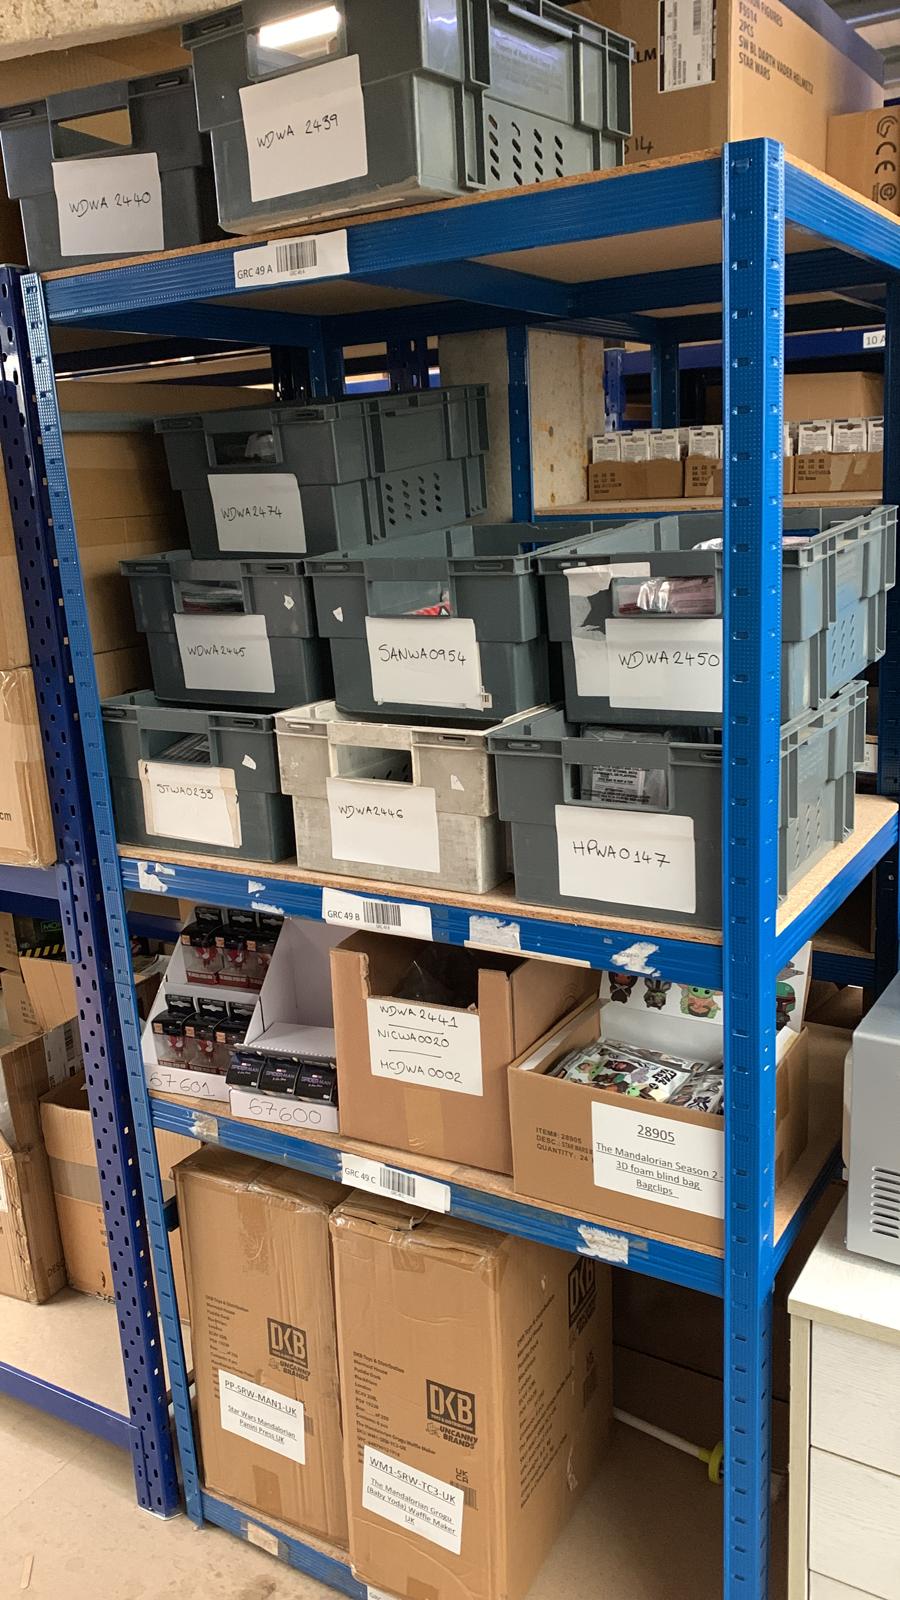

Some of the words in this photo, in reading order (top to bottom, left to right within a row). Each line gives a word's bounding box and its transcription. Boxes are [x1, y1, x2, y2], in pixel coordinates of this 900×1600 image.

[738, 52, 754, 70] STAR
[754, 61, 770, 80] WARS
[758, 46, 776, 68] DARTH
[776, 60, 792, 80] VADER
[256, 124, 295, 149] WDWA
[304, 113, 338, 135] 2439
[69, 196, 108, 218] WDWA
[114, 191, 151, 207] 2440
[237, 268, 254, 280] GRC
[255, 265, 265, 276] 49
[266, 264, 273, 274] A
[866, 336, 878, 346] 10
[378, 643, 466, 666] SANWA0954
[156, 782, 214, 800] STWA0233
[338, 804, 404, 820] WDWA2446
[572, 839, 671, 868] HPWA0147
[327, 910, 343, 919] GRC
[344, 912, 354, 920] 49
[636, 1124, 676, 1142] 28905
[596, 1142, 613, 1154] The
[615, 1146, 673, 1168] Mandalorian
[675, 1162, 710, 1178] Season
[712, 1170, 718, 1179] 2
[344, 1168, 360, 1178] GRC
[360, 1173, 369, 1182] 49
[616, 1160, 628, 1170] 3D
[630, 1164, 654, 1177] foam
[656, 1170, 680, 1184] blind
[636, 1179, 673, 1196] Bagclips
[270, 1322, 306, 1360] DKB
[280, 1360, 311, 1376] UNCANNY
[283, 1368, 308, 1381] BRANDS
[225, 1380, 297, 1416] PP-SRW-MAN1-UK
[430, 1384, 472, 1424] DKB
[228, 1404, 239, 1414] Star
[241, 1410, 256, 1422] Wars
[258, 1418, 296, 1439] Mandalorian
[259, 1426, 274, 1440] Press
[276, 1434, 285, 1443] UK
[440, 1425, 478, 1444] UNCANNY
[443, 1434, 475, 1449] BRANDS
[370, 1456, 456, 1502] WM1-SRW-TC3-UK
[455, 1467, 469, 1476] UK
[367, 1486, 385, 1500] (Baby
[387, 1495, 407, 1511] Yoda)
[408, 1506, 431, 1521] Waffle
[433, 1518, 456, 1534] Maker
[371, 1477, 383, 1488] The
[385, 1485, 429, 1512] Mandalorian
[430, 1508, 452, 1523] Grogu
[405, 1515, 414, 1523] UK
